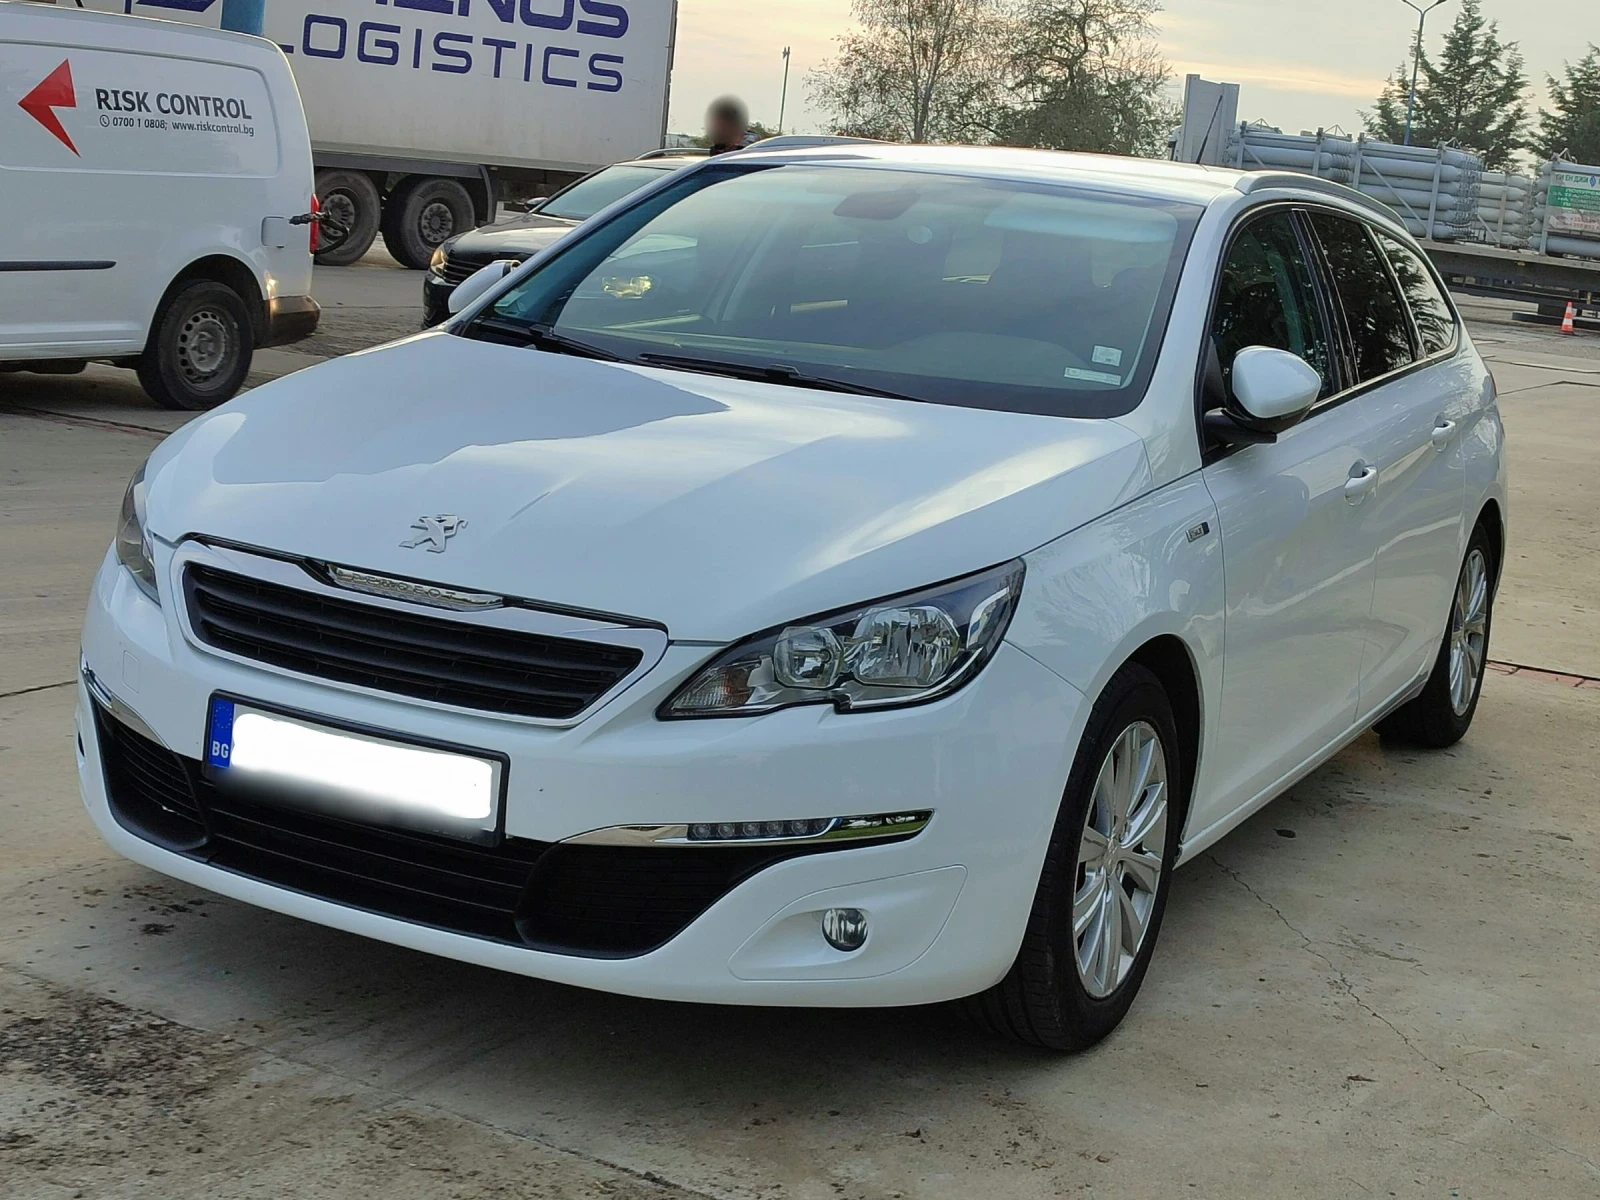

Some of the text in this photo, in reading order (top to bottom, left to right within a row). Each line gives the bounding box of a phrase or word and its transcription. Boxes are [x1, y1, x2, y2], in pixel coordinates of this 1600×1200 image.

[280, 14, 625, 92] OGISTICS
[95, 88, 252, 120] RISK CONTROL
[112, 117, 134, 127] 0700
[137, 118, 141, 128] 1
[172, 121, 254, 137] www.riskcontrol.bg
[212, 740, 229, 759] BG
